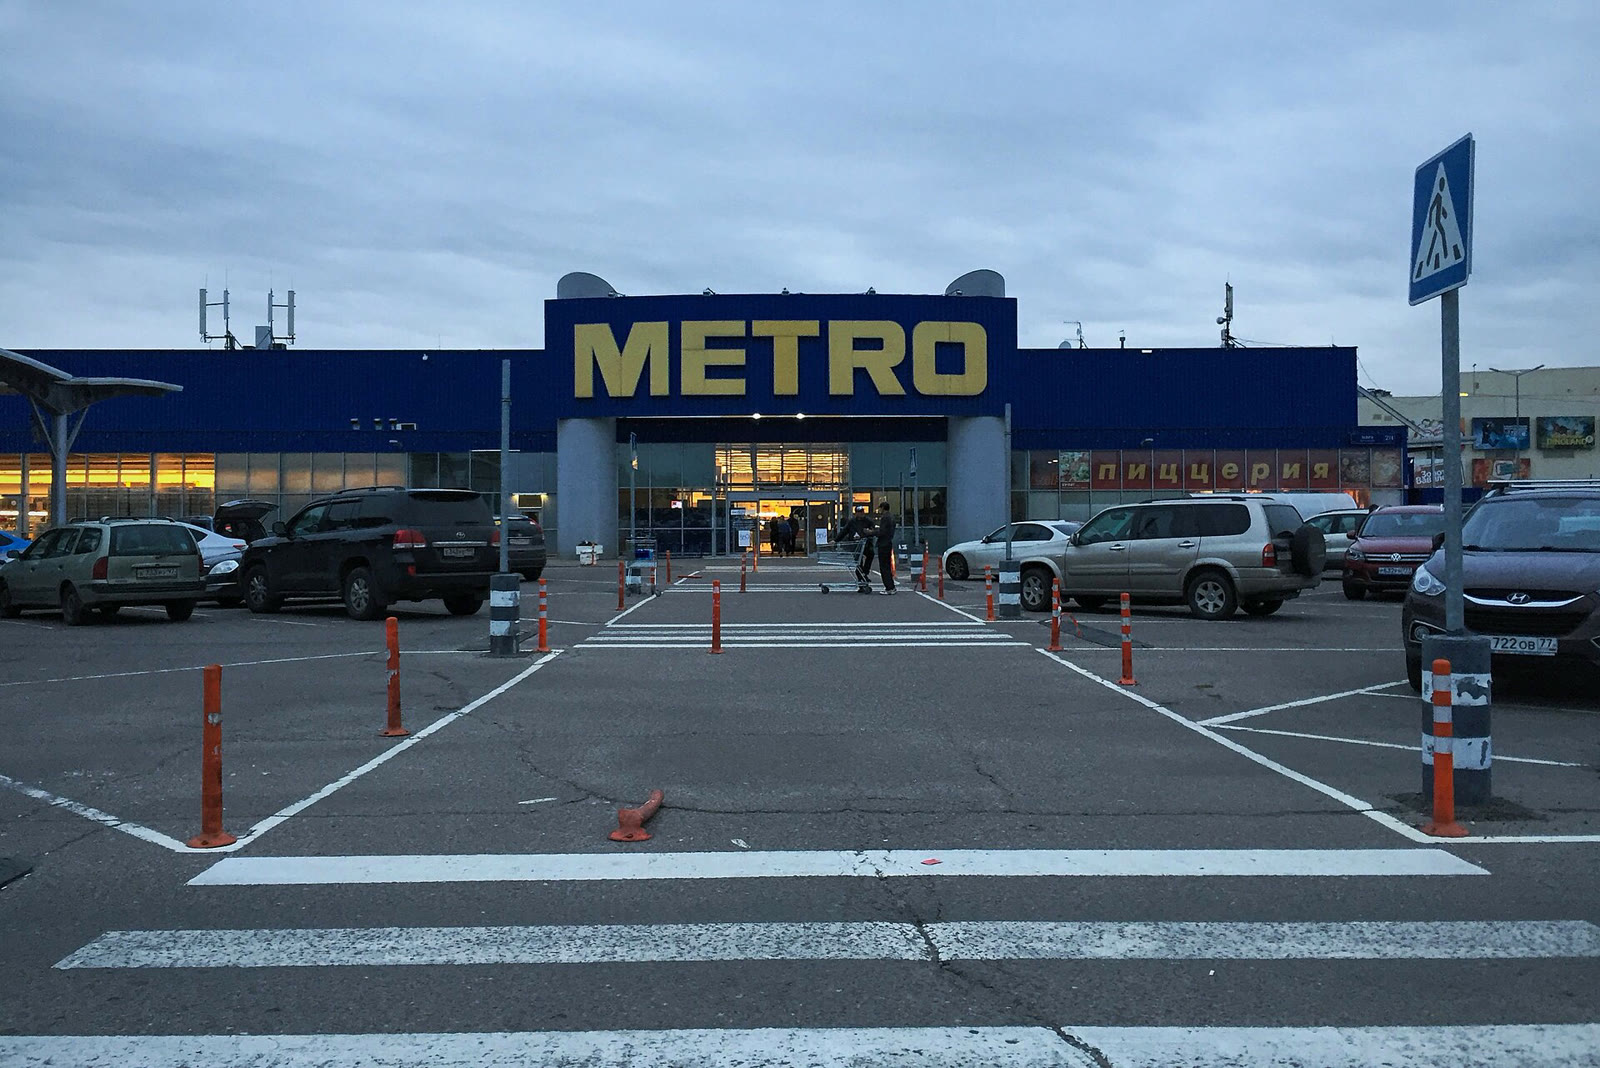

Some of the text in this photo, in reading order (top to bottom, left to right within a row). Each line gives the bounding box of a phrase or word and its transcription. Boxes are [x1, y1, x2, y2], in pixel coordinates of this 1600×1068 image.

[574, 320, 988, 398] METRO
[1098, 462, 1329, 485] пиццерия
[1492, 637, 1553, 650] 722ОВ 77
